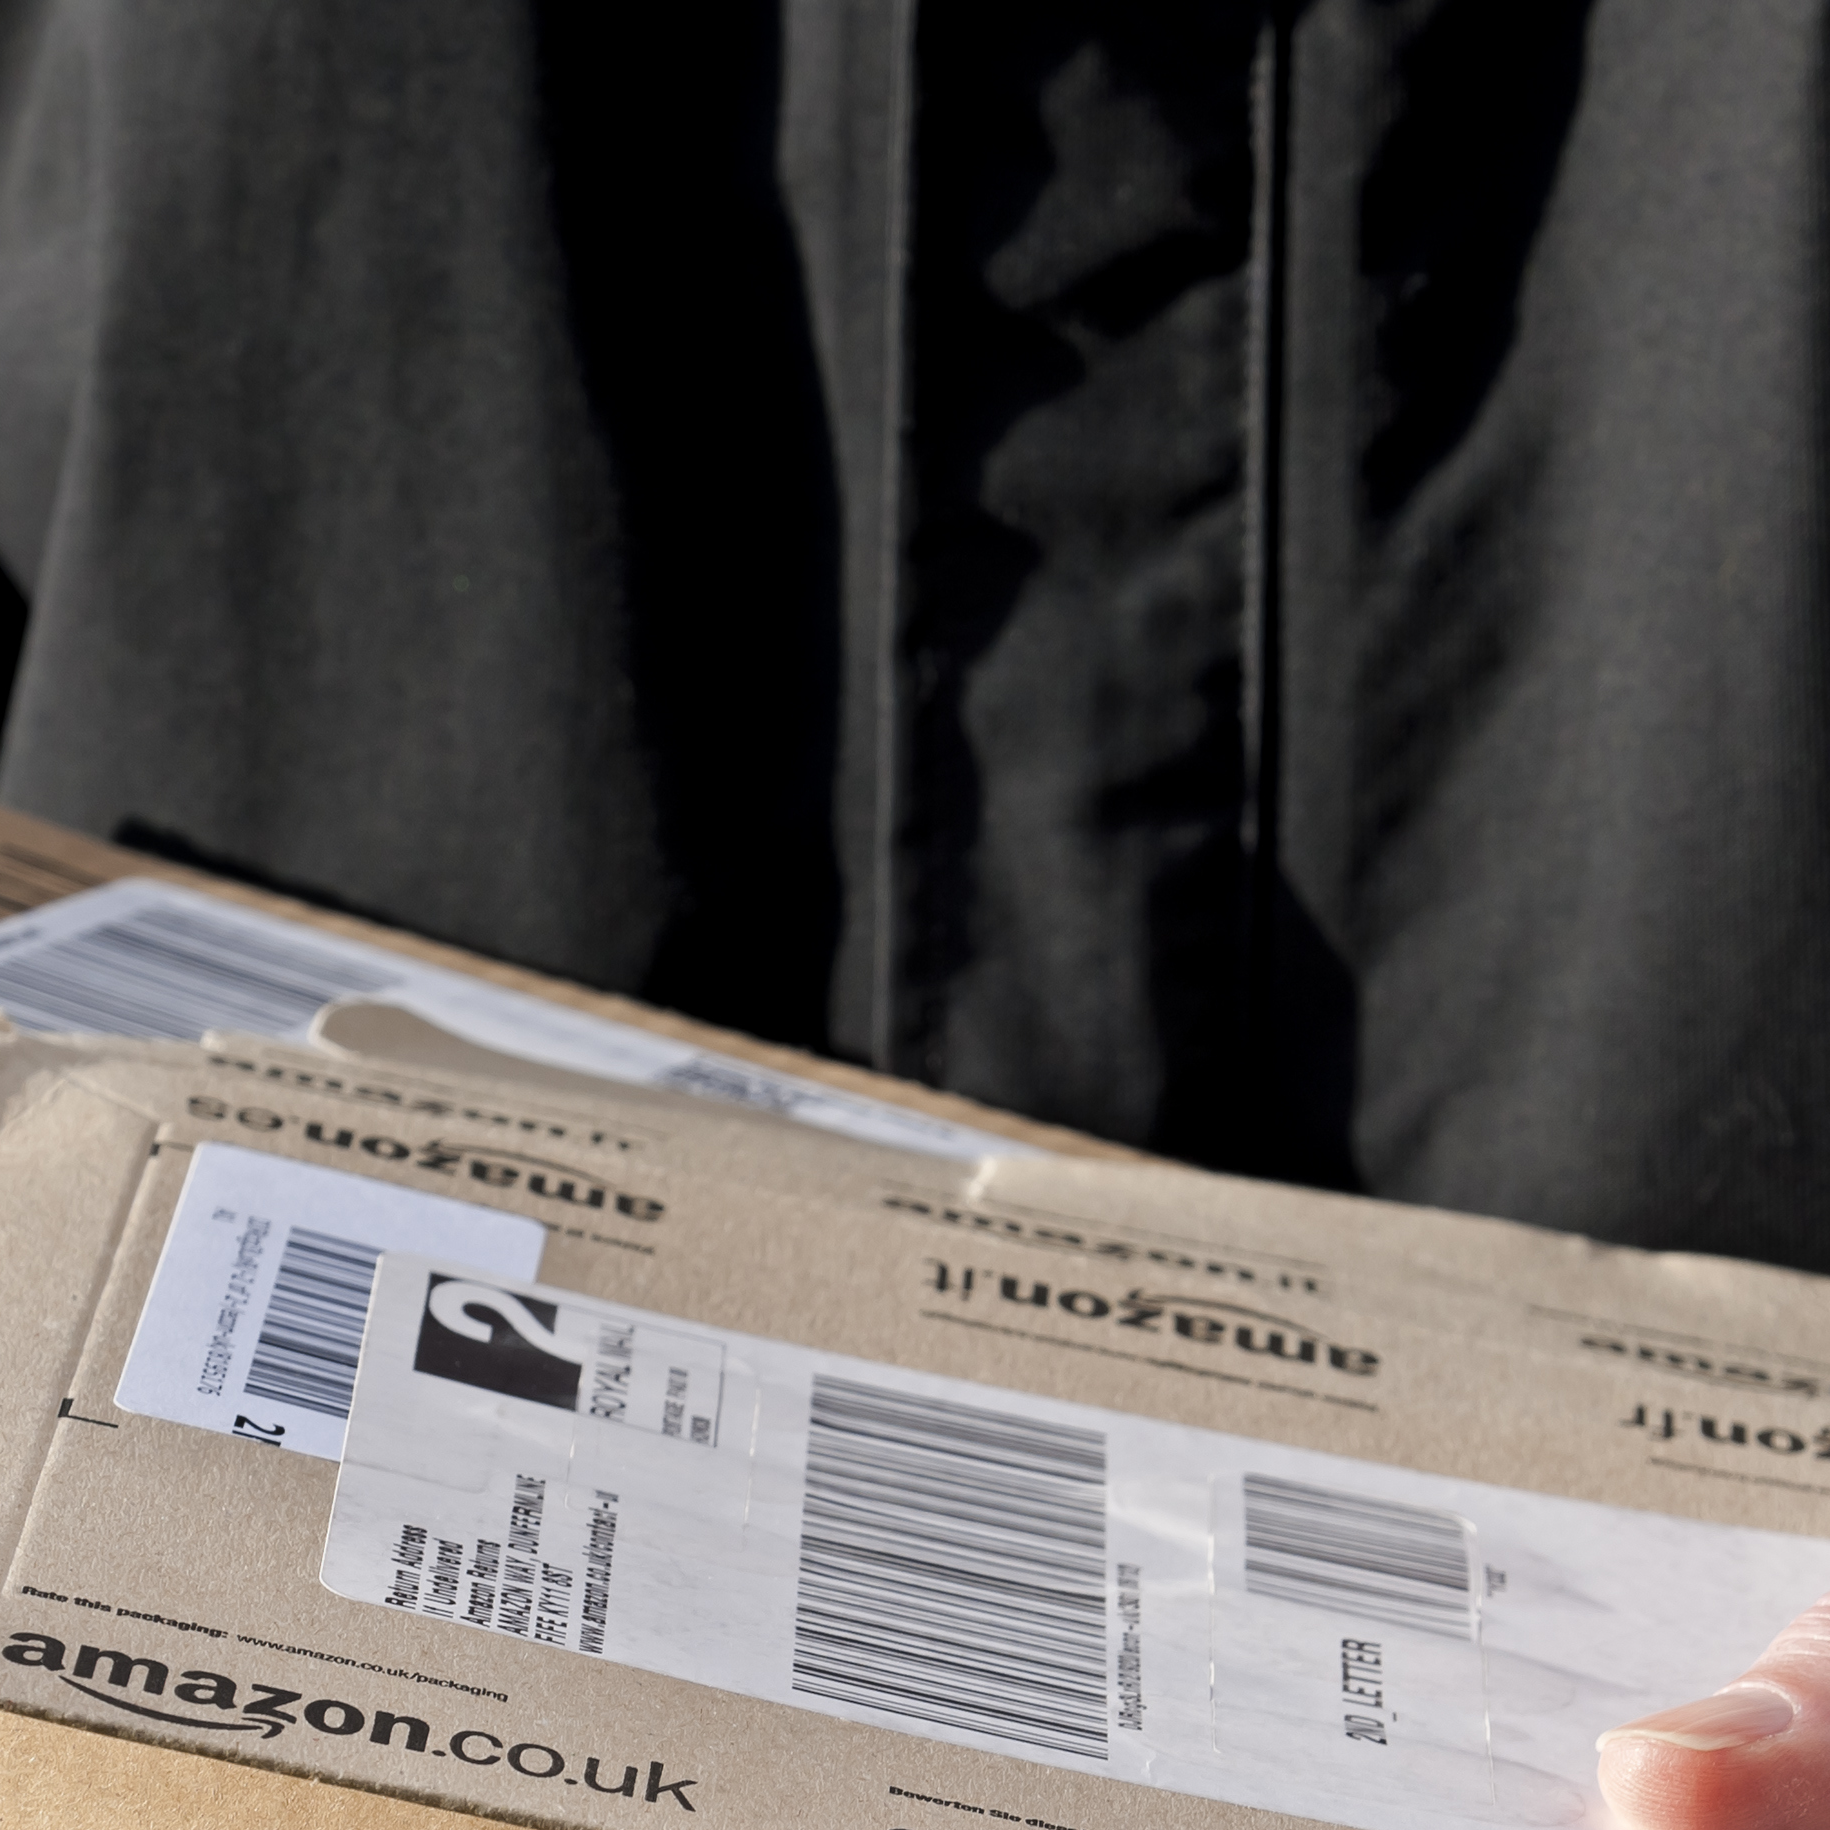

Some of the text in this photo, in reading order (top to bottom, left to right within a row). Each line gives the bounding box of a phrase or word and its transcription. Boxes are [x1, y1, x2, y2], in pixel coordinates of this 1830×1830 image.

[187, 1095, 666, 1224] amazon.es
[919, 1256, 1382, 1379] amazon.it
[589, 1361, 632, 1424] ROYAL
[384, 1523, 428, 1610] Return Address
[422, 1536, 464, 1619] If Undelivered
[459, 1538, 502, 1629] Amazon Returns
[496, 1473, 546, 1637] AMAZON WAY, DUNFERMLINE
[21, 1585, 509, 1703] Rate this packaging: www.amazon.co.uk/packaging
[533, 1561, 574, 1647] FIFE KY11 8ST
[0, 1630, 700, 1812] amazon.co.uk
[888, 1785, 985, 1815] Bewerten
[988, 1808, 1022, 1822] Sie
